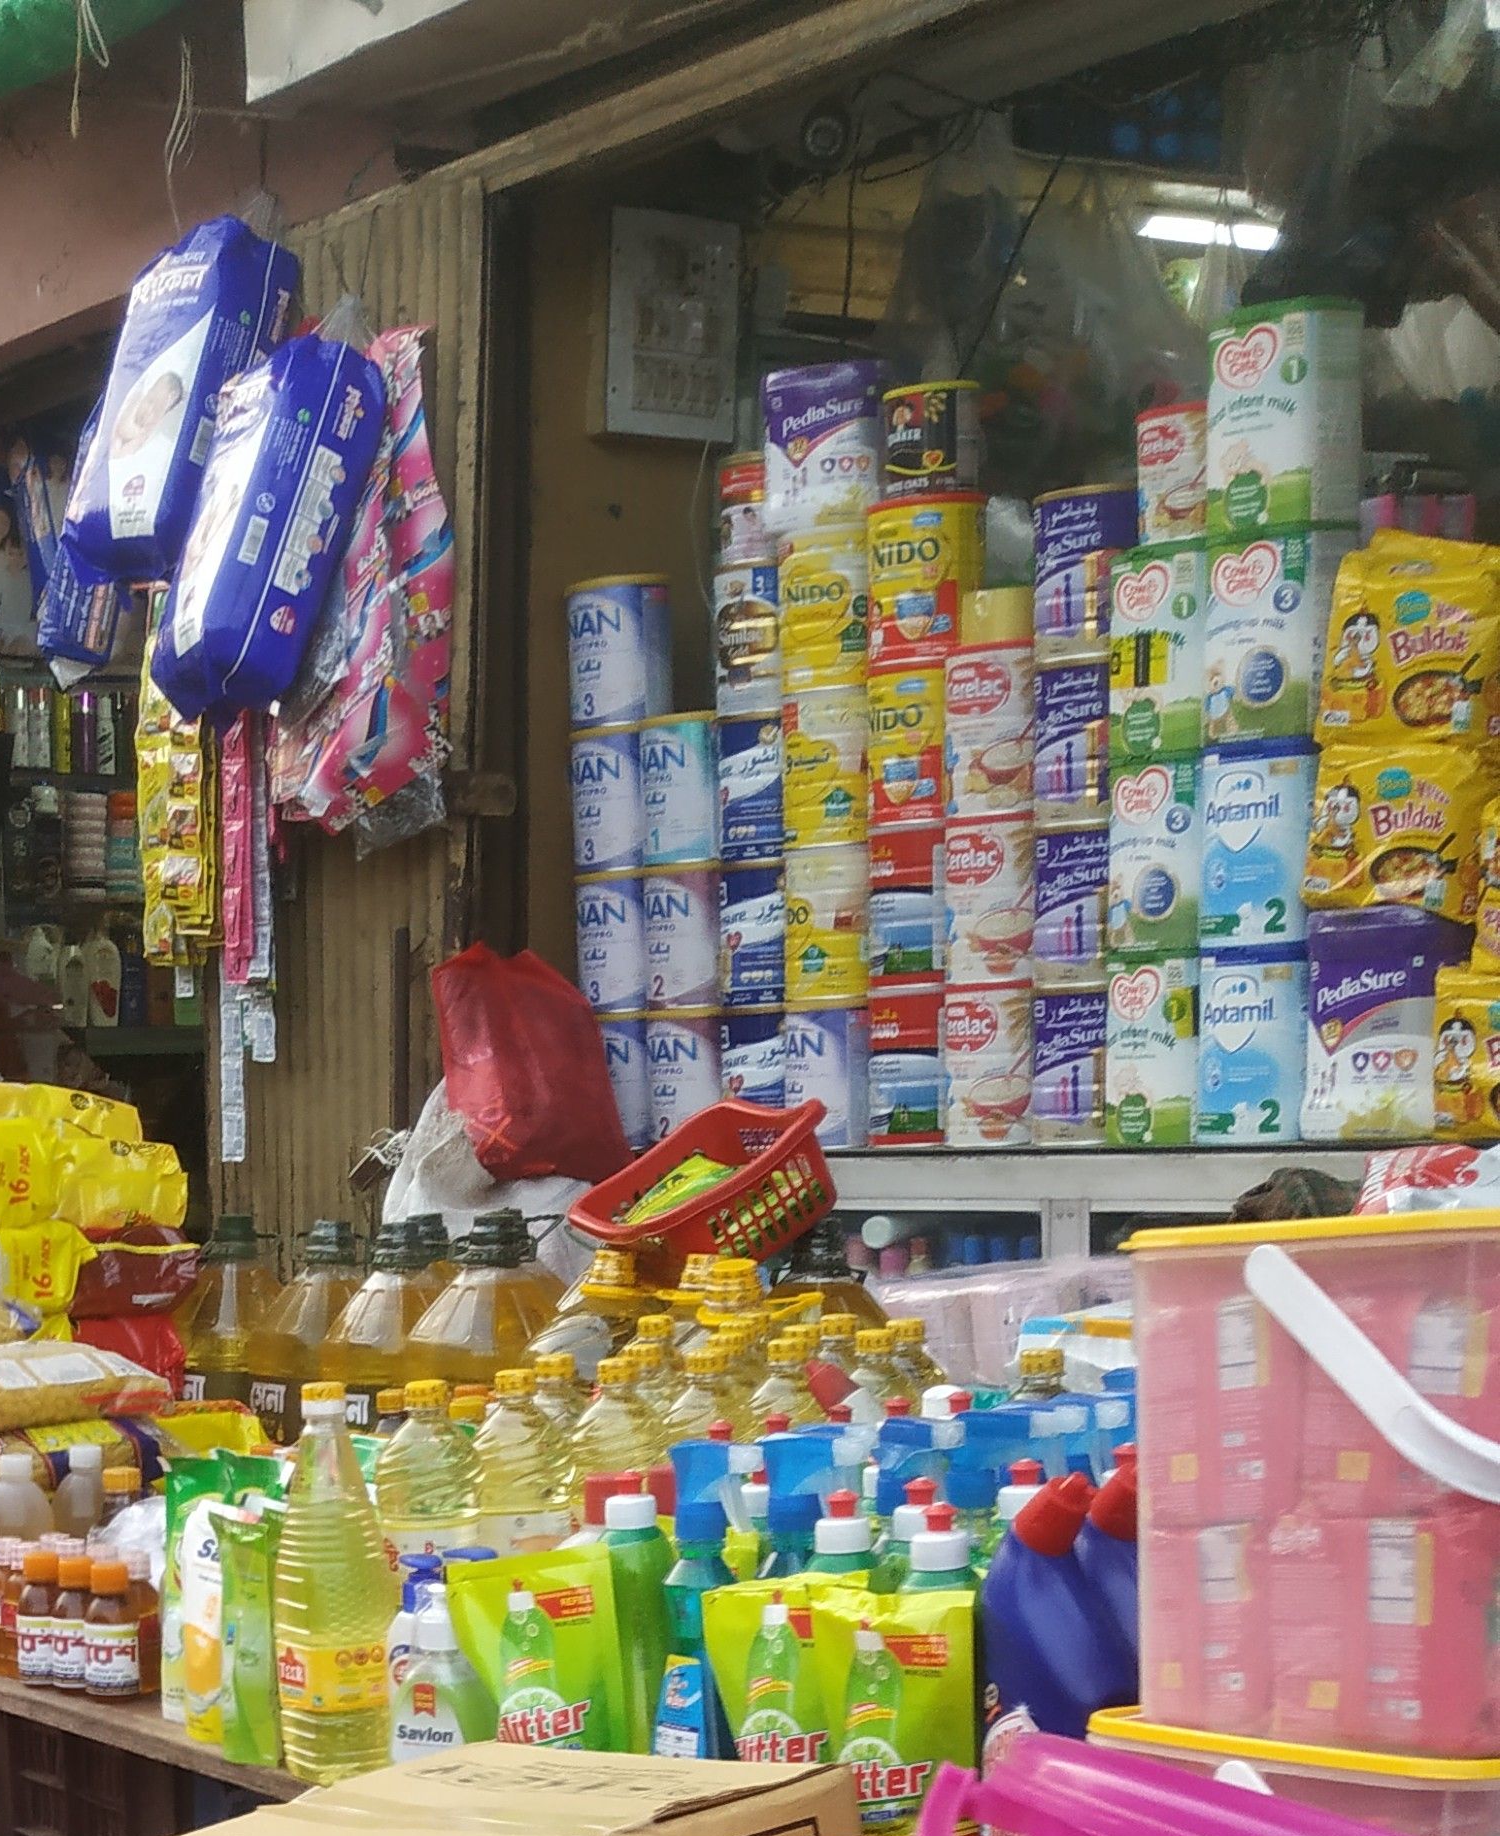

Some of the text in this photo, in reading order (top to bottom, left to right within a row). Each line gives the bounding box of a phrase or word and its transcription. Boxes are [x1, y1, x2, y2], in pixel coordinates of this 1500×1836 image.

[1288, 359, 1299, 382] 1
[782, 397, 864, 437] PediaSure
[873, 537, 940, 568] NIDO
[755, 576, 765, 596] 3
[786, 581, 844, 603] NIDO
[1180, 596, 1189, 617] 1
[1281, 588, 1293, 609] 3
[583, 692, 595, 717] 3
[1172, 810, 1184, 828] 3
[1205, 792, 1280, 827] Aptamil
[584, 839, 595, 861] 3
[650, 827, 661, 850] 1
[1263, 897, 1287, 934] 2
[589, 980, 600, 1002] 3
[653, 975, 666, 998] 2
[1315, 967, 1407, 1013] PediaSure
[1203, 997, 1275, 1027] Aptamil
[786, 1031, 824, 1060] AN
[658, 1116, 671, 1139] 2
[1258, 1099, 1281, 1134] 2
[8, 1177, 31, 1206] 16
[31, 1272, 53, 1299] 16
[396, 1724, 454, 1744] Savlon
[854, 1759, 934, 1802] tter
